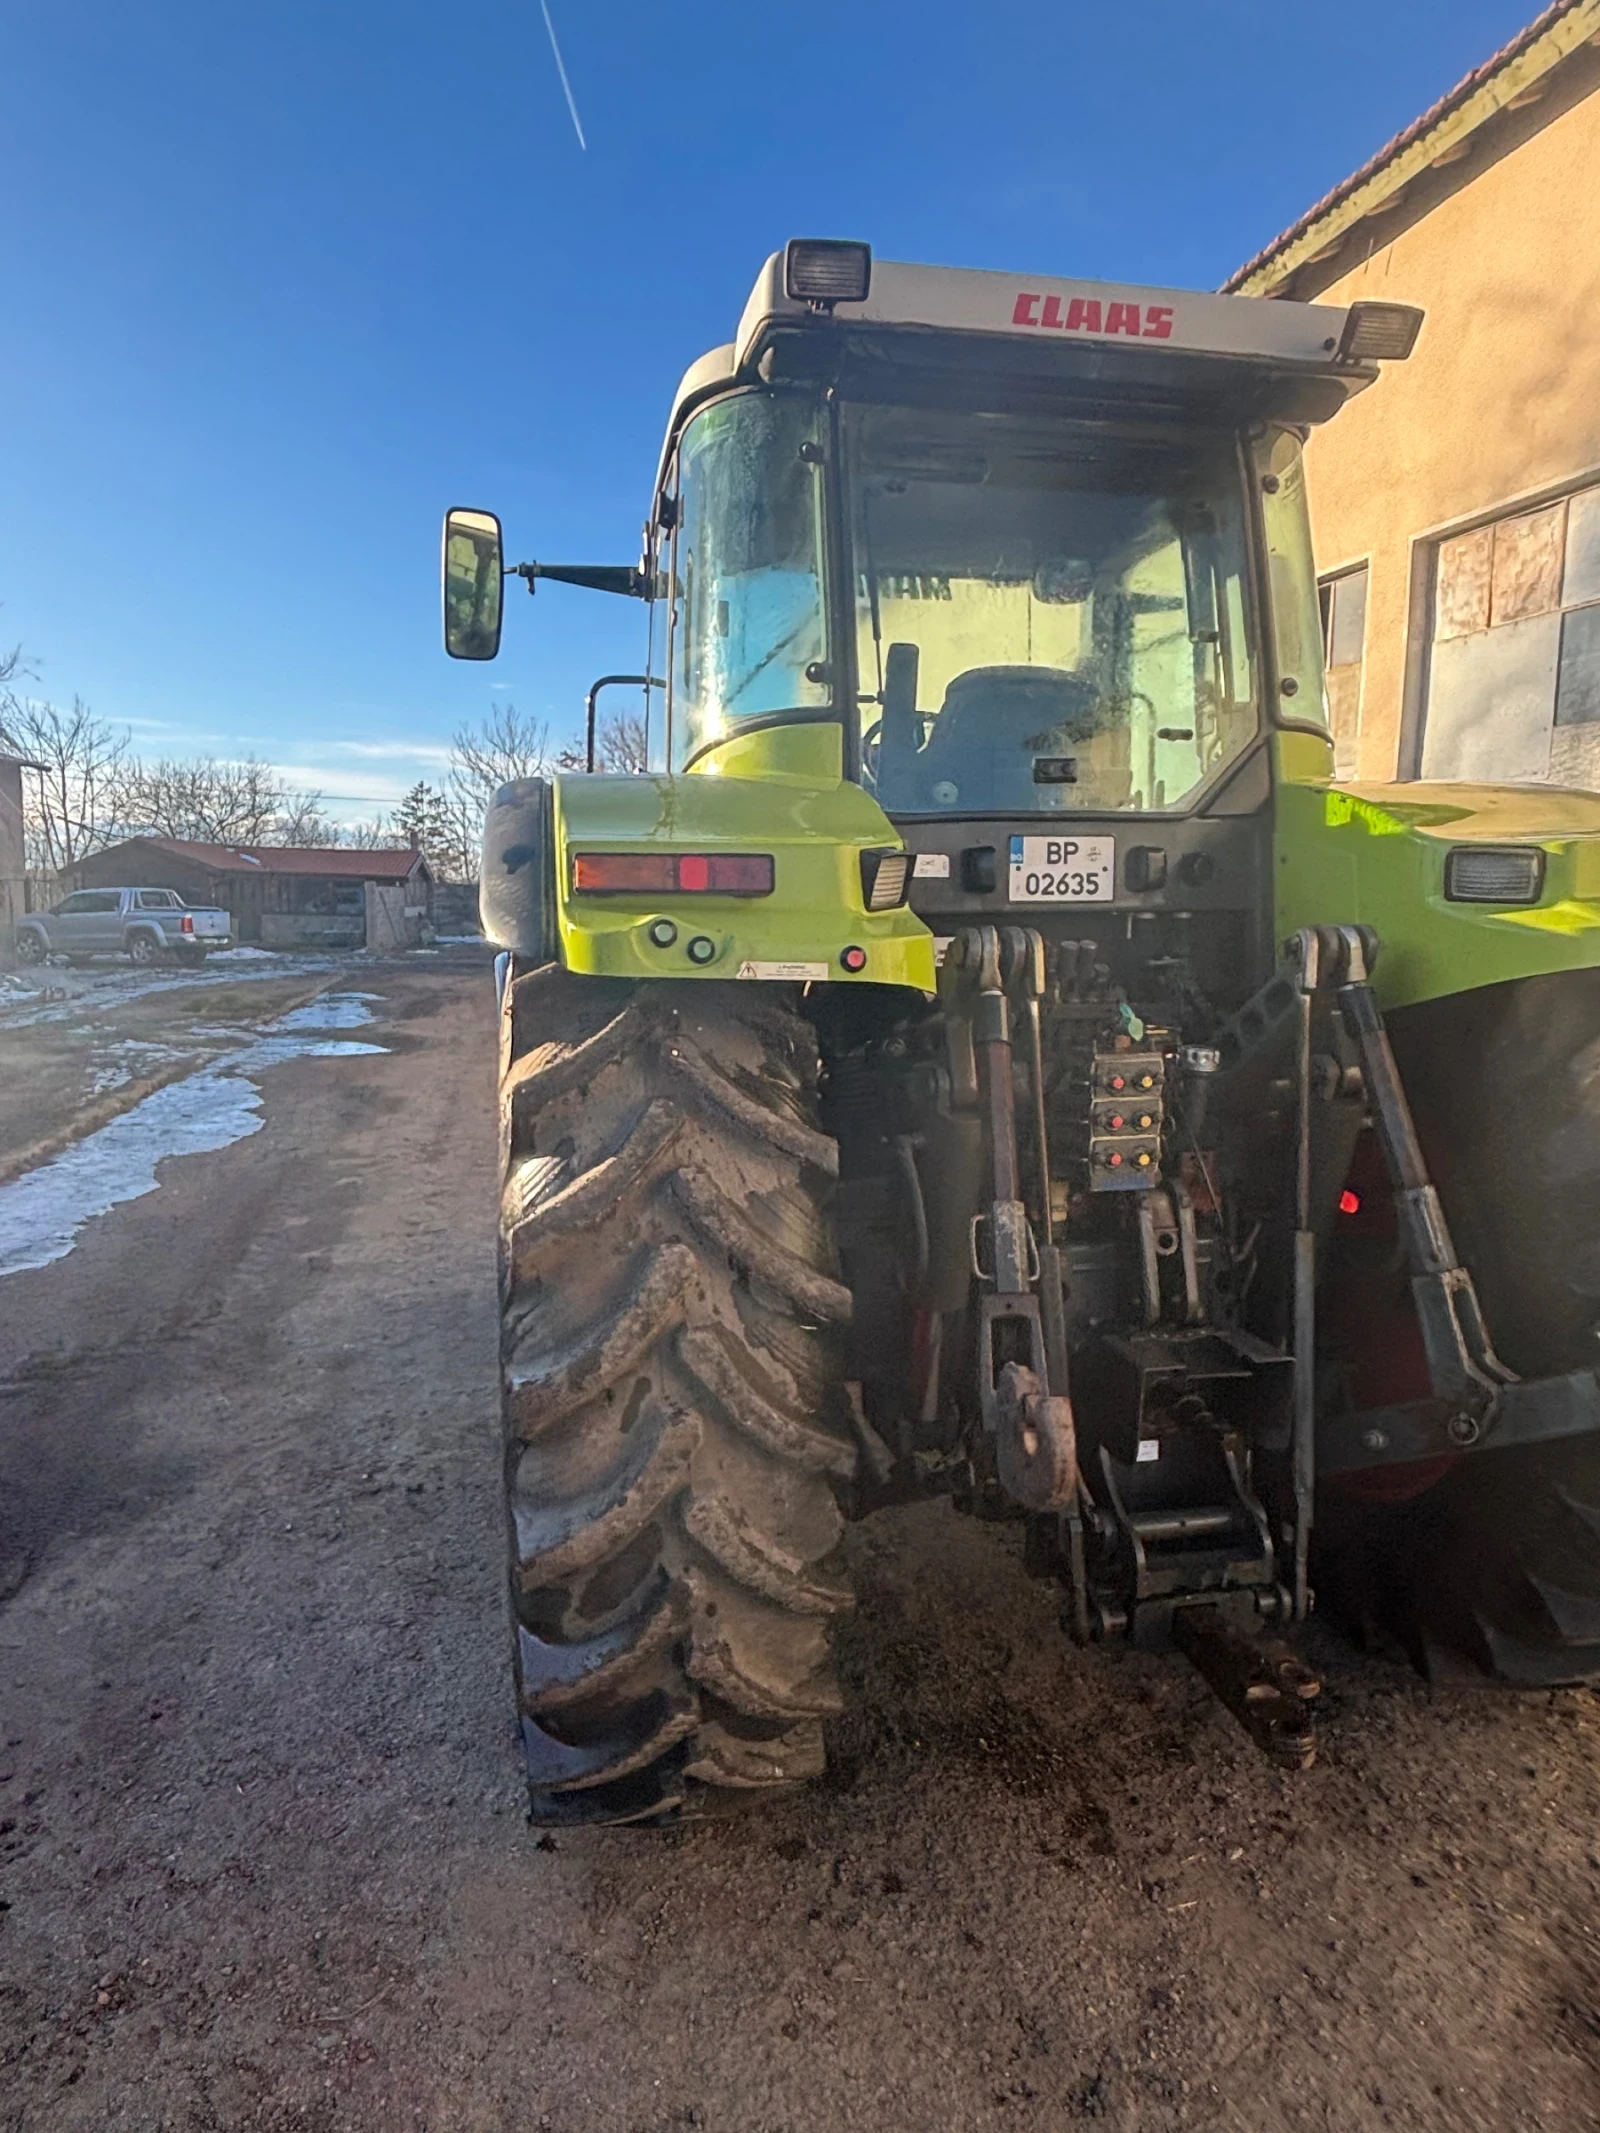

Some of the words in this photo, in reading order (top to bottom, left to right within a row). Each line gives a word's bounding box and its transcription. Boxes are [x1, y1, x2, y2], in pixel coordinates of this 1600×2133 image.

[1012, 293, 1174, 339] CLAAS
[1046, 841, 1079, 865] BP
[1025, 872, 1100, 896] 02635
